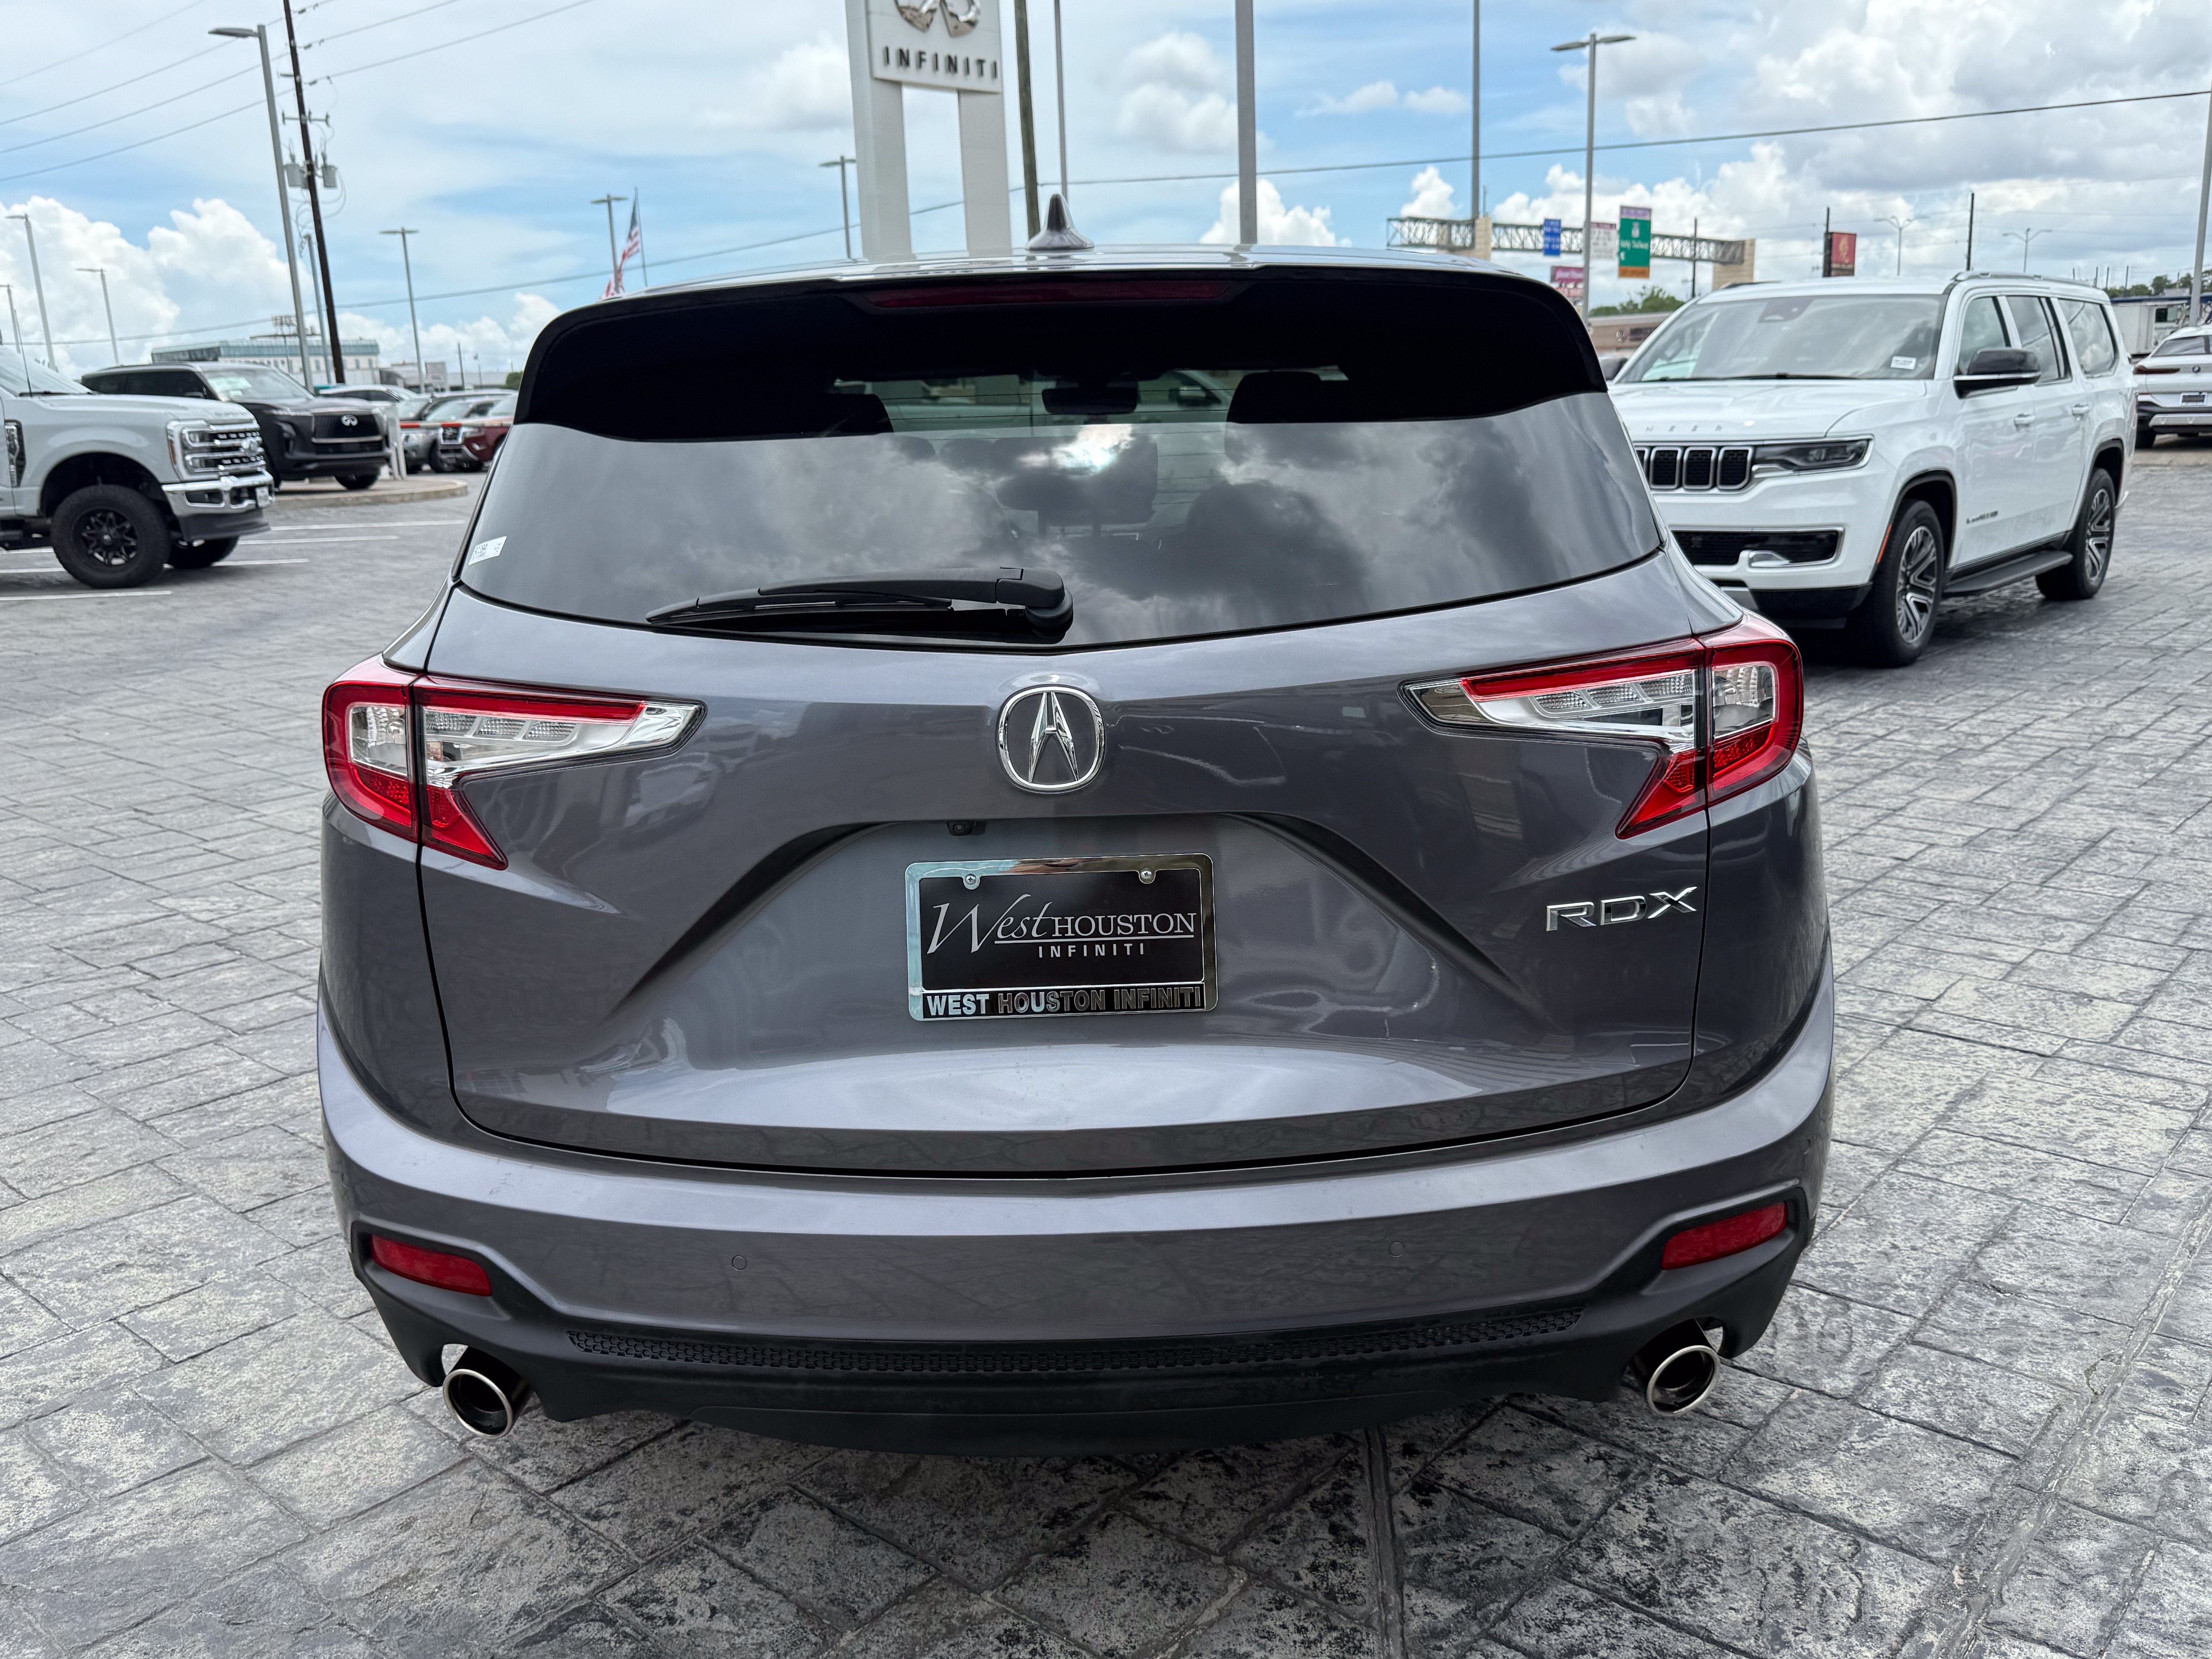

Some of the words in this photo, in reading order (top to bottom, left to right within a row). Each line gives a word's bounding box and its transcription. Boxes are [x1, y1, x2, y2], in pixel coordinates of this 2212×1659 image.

[884, 45, 998, 79] INFINITI
[927, 893, 1053, 955] West
[1053, 912, 1197, 937] HOUSTON
[1546, 886, 1697, 932] RDX
[1039, 943, 1145, 958] INFINITI
[927, 994, 989, 1016] WEST
[998, 990, 1106, 1013] HOUSTON
[1114, 986, 1201, 1010] INFINITI
